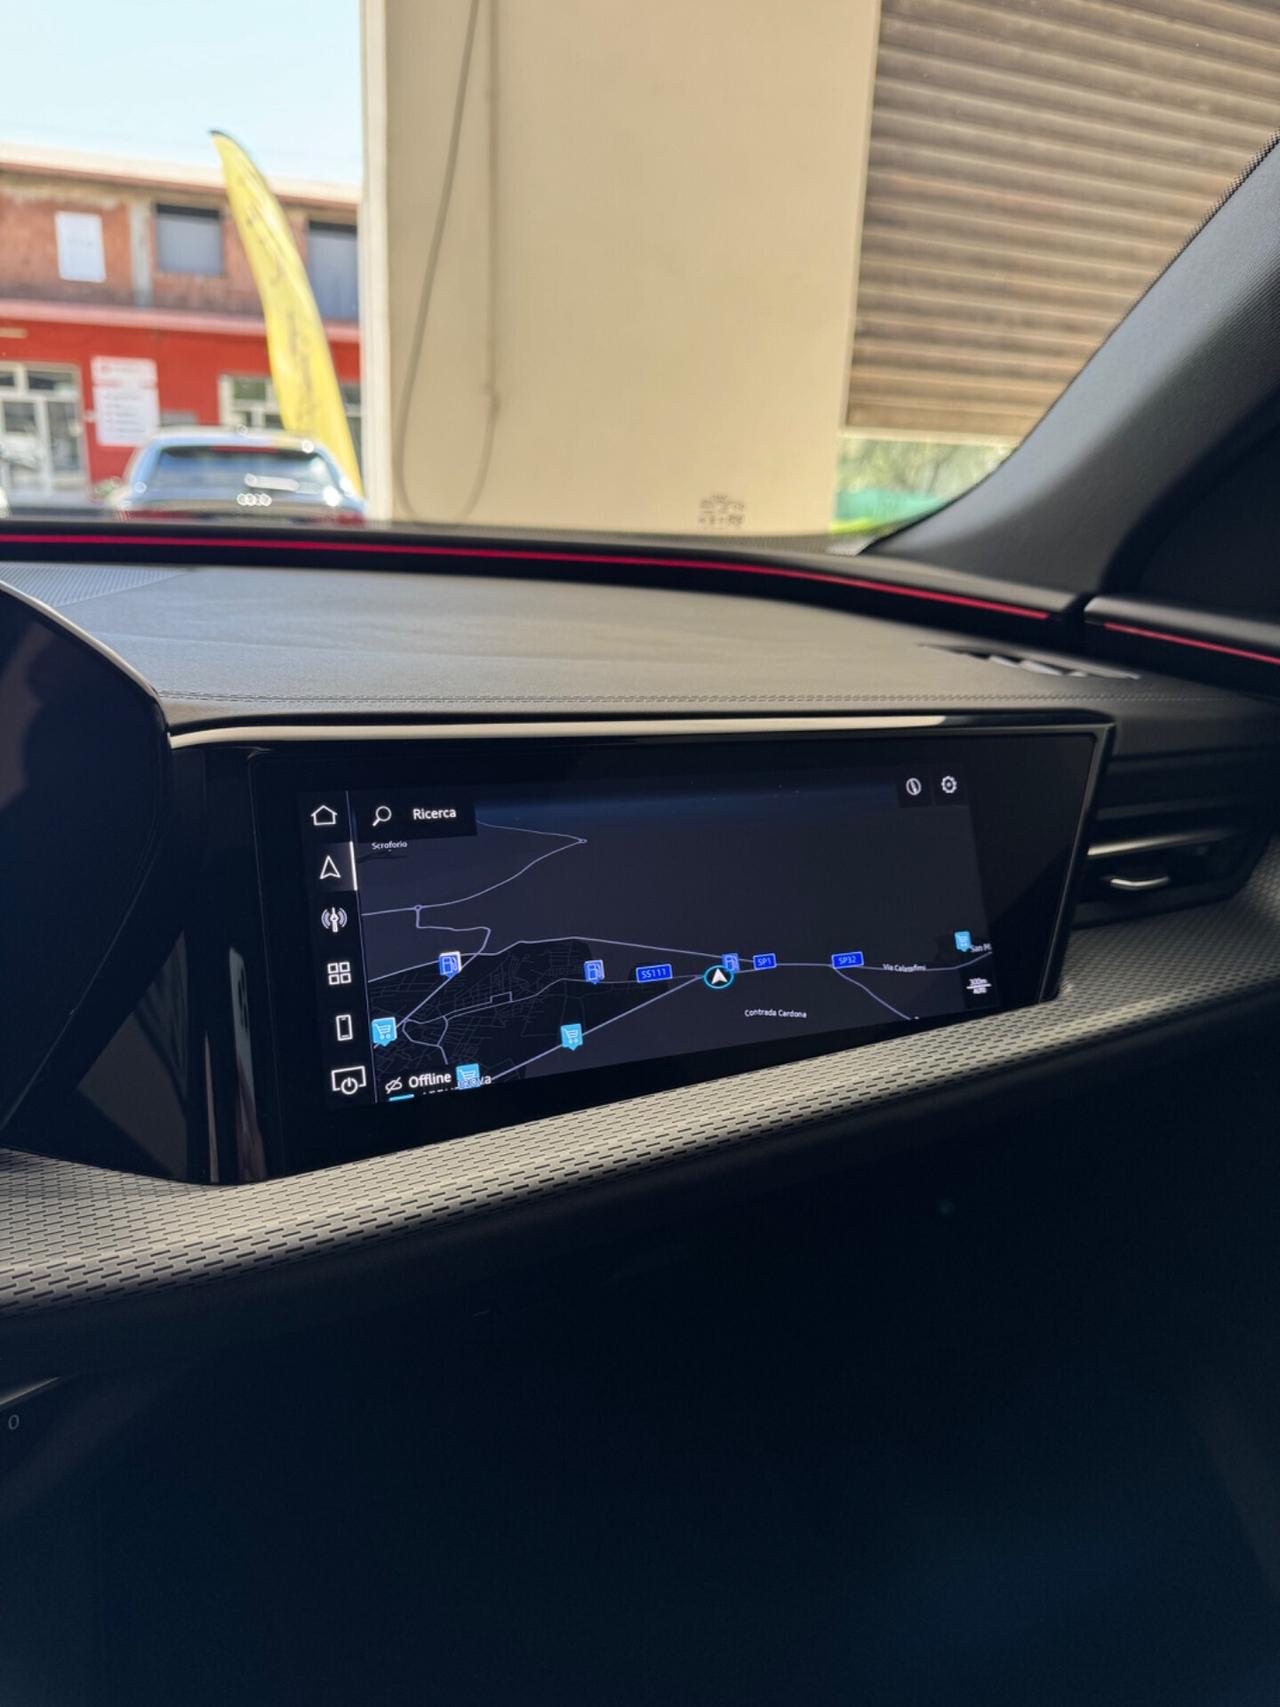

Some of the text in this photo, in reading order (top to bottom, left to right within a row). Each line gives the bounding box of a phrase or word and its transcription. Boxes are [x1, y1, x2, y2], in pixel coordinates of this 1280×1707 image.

[413, 808, 457, 820] Ricerca
[757, 956, 772, 967] SP1
[641, 967, 667, 979] SS111
[744, 1008, 807, 1018] Contrada Cardona
[408, 1073, 452, 1088] Offline
